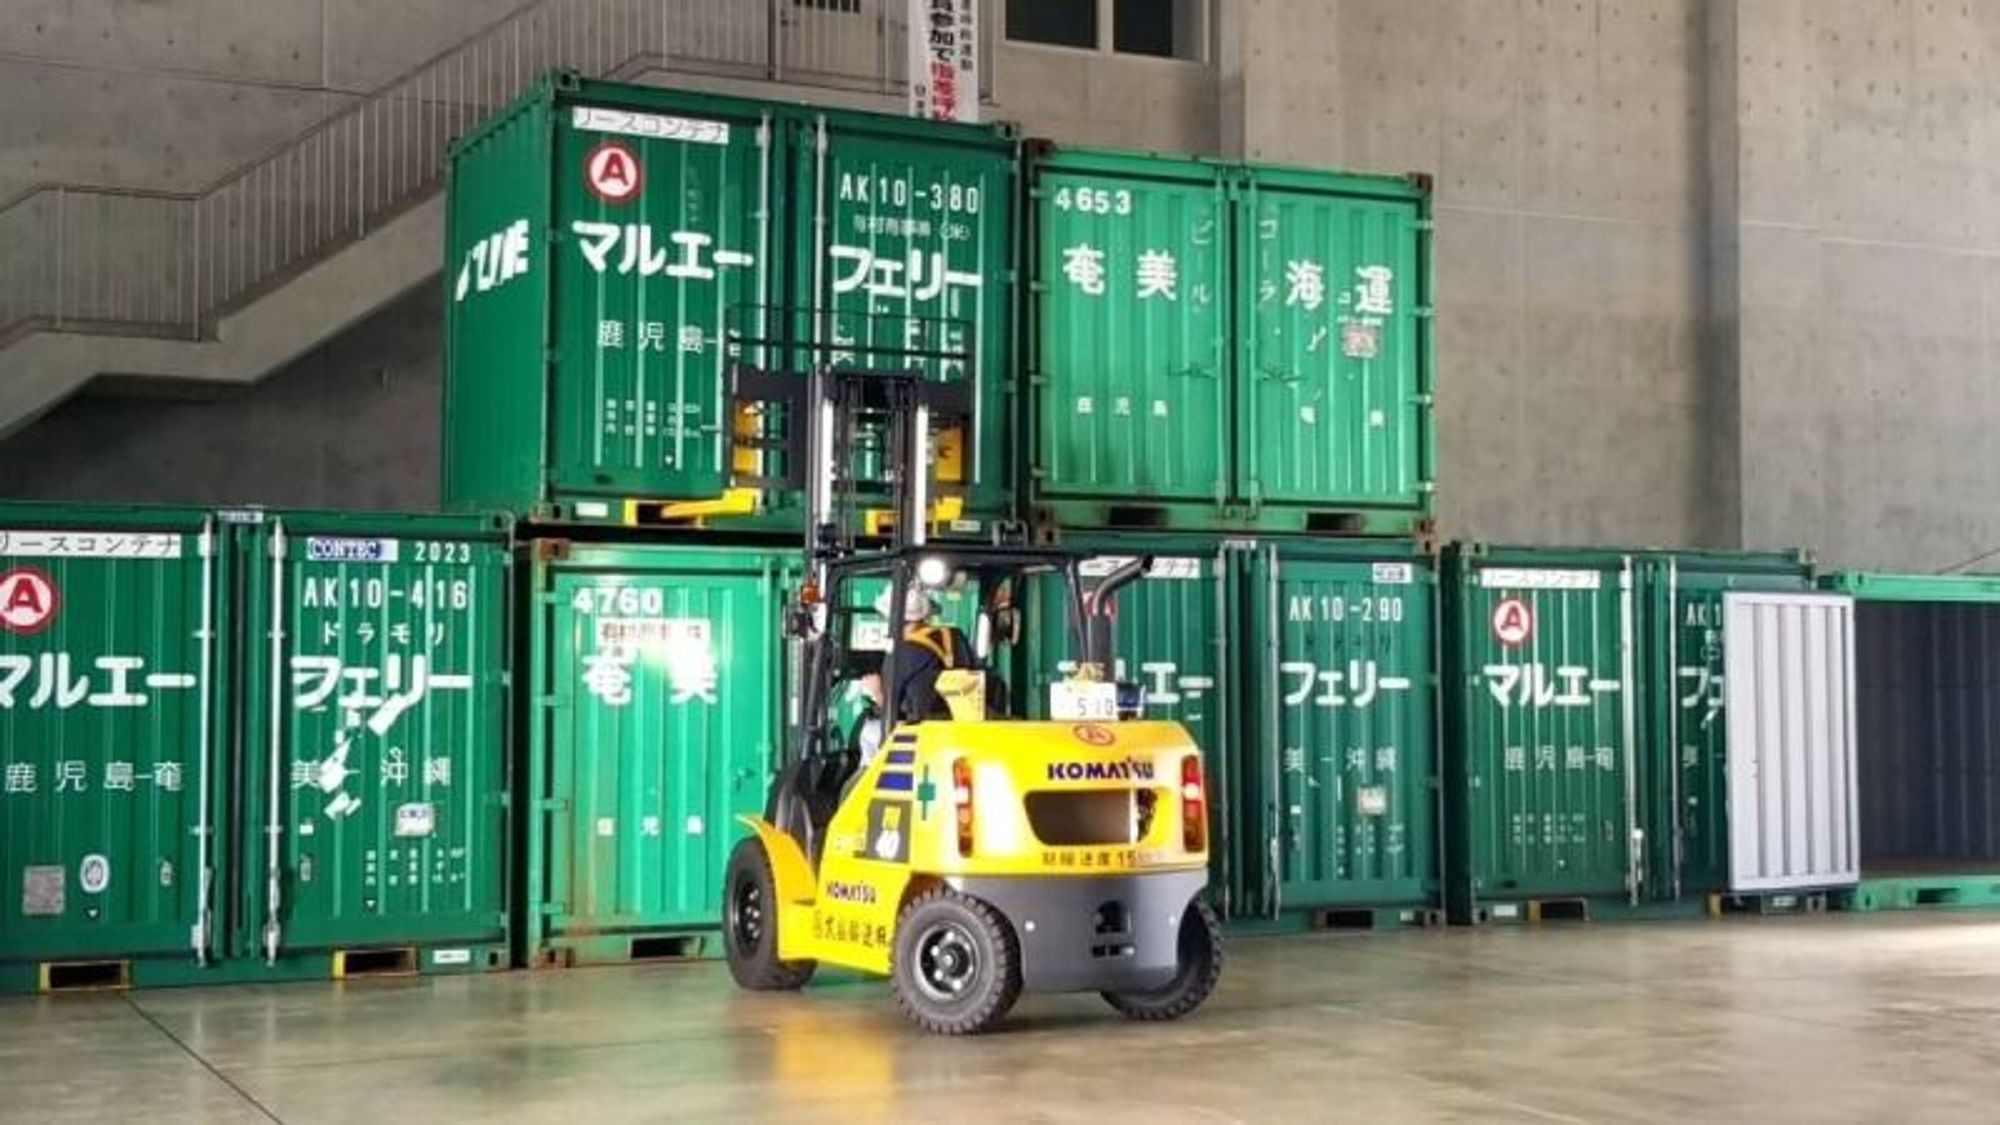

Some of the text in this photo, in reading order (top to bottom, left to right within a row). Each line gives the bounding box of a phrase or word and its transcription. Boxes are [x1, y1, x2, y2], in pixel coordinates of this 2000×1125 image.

[1054, 187, 1132, 214] 4653
[572, 220, 754, 279] マルエー
[828, 244, 983, 300] フェリー
[1062, 243, 1178, 302] 奄美
[1284, 259, 1394, 314] 海運
[415, 541, 471, 563] 2023
[573, 587, 663, 615] 4760
[323, 620, 444, 646] ドラモリ
[1280, 659, 1411, 708] フェリー
[1483, 663, 1621, 708] マルエー
[1047, 757, 1155, 780] KOMATSU
